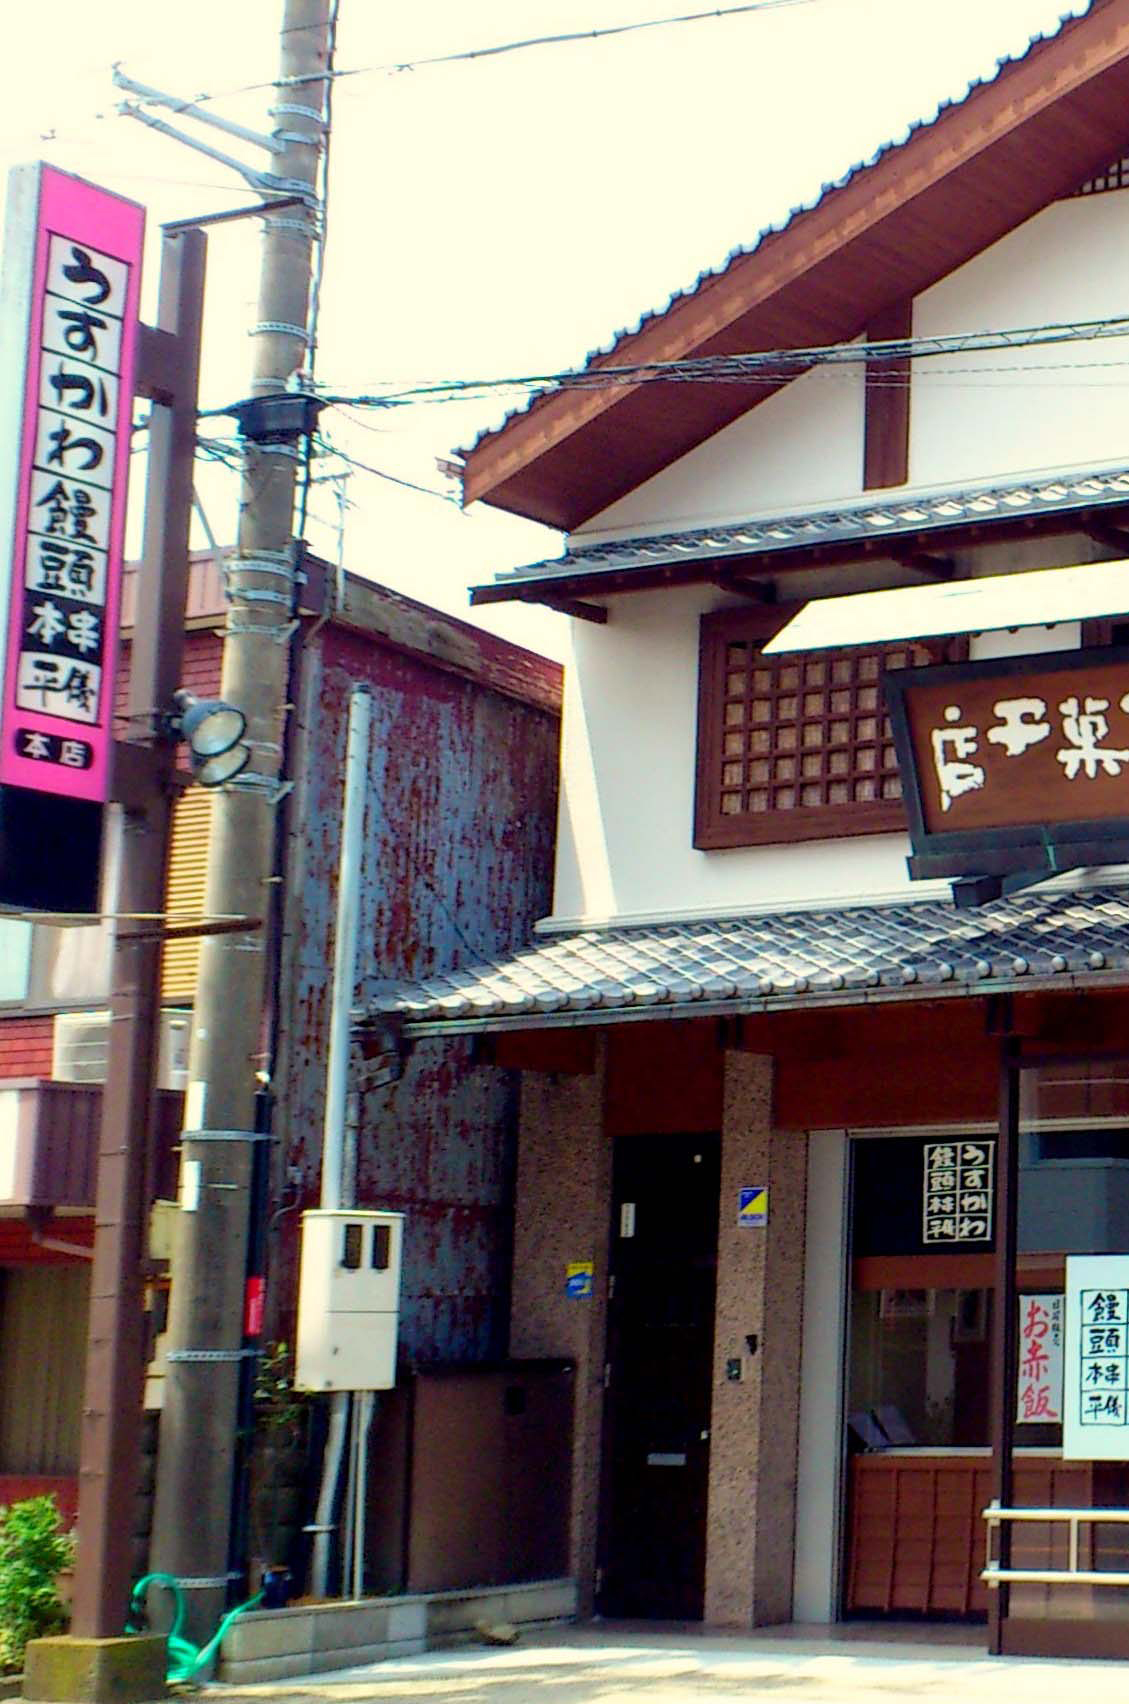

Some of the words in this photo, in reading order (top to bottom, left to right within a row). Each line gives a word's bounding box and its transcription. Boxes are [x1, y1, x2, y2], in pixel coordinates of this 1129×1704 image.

[22, 732, 86, 769] 本店
[960, 1144, 987, 1237] うすかわ
[1022, 1300, 1058, 1419] お赤飯
